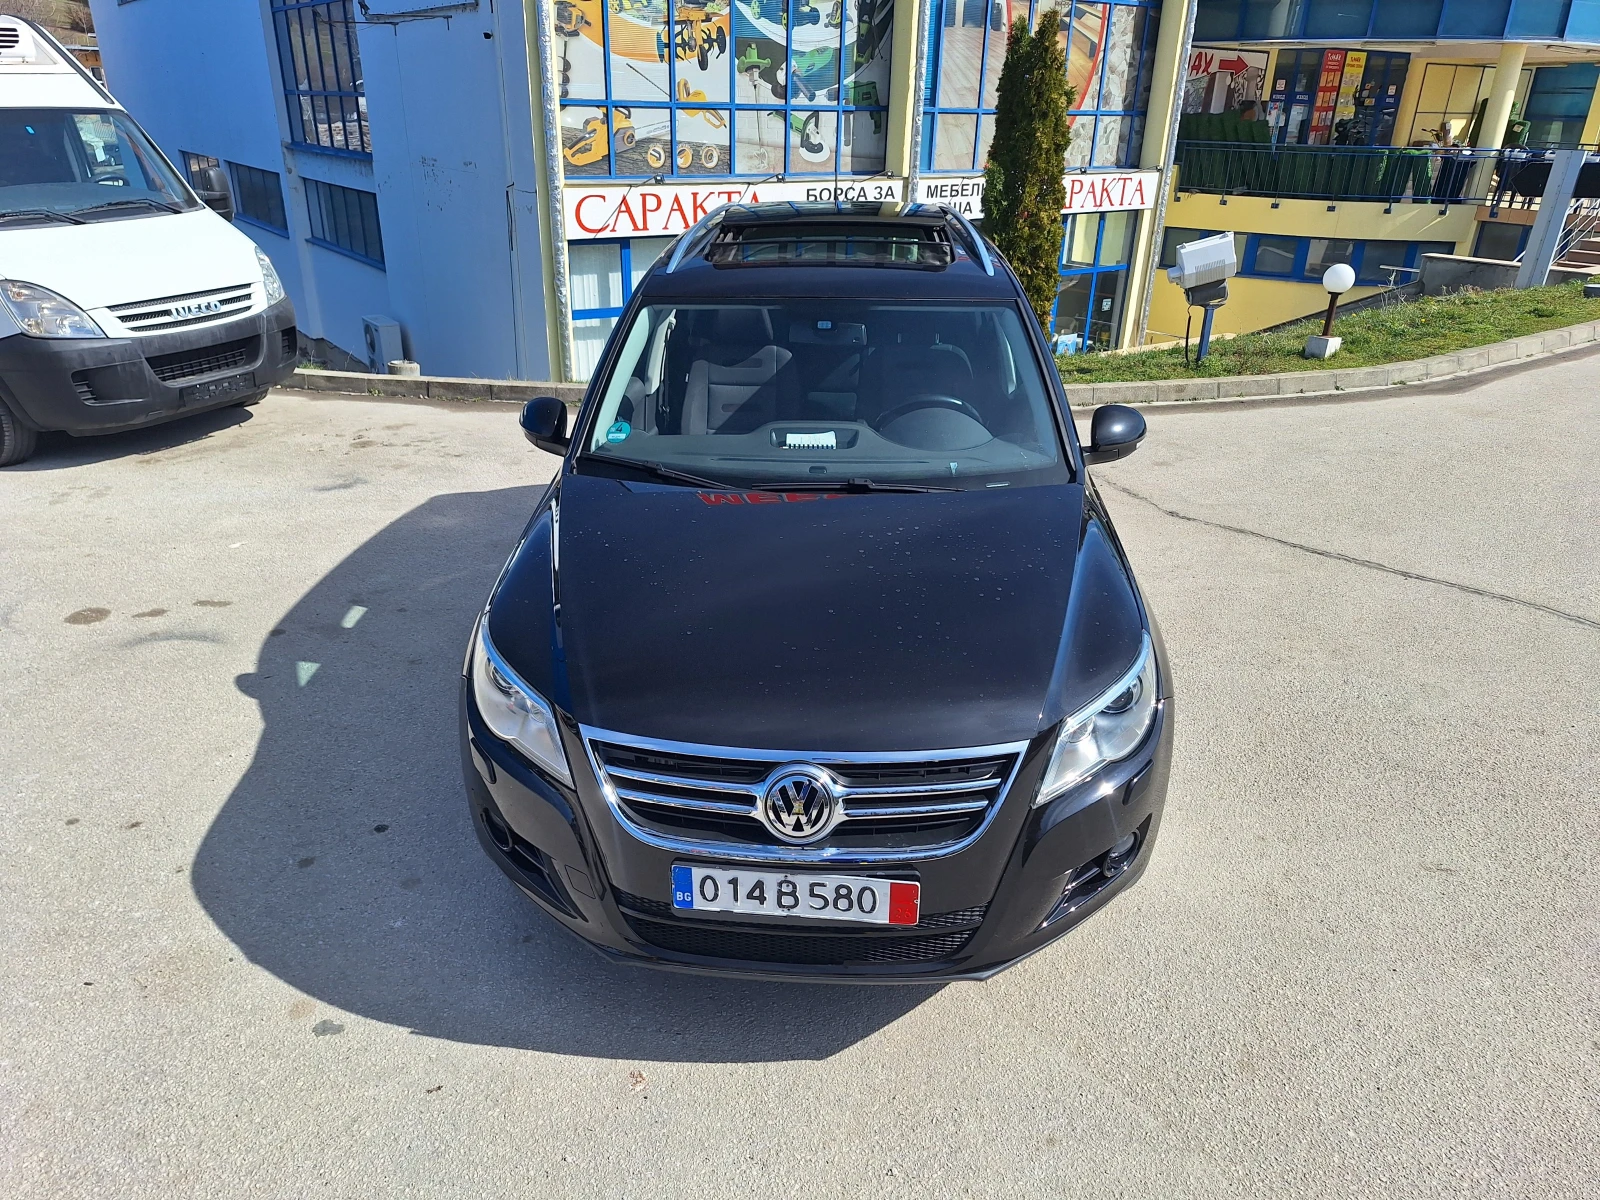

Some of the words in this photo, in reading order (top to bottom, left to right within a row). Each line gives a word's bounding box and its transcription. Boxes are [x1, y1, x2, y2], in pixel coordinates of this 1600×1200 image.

[1188, 51, 1214, 77] AX
[806, 186, 868, 202] БОРСА
[873, 185, 896, 201] ЗА
[169, 299, 222, 320] IVECO
[676, 891, 692, 902] BG
